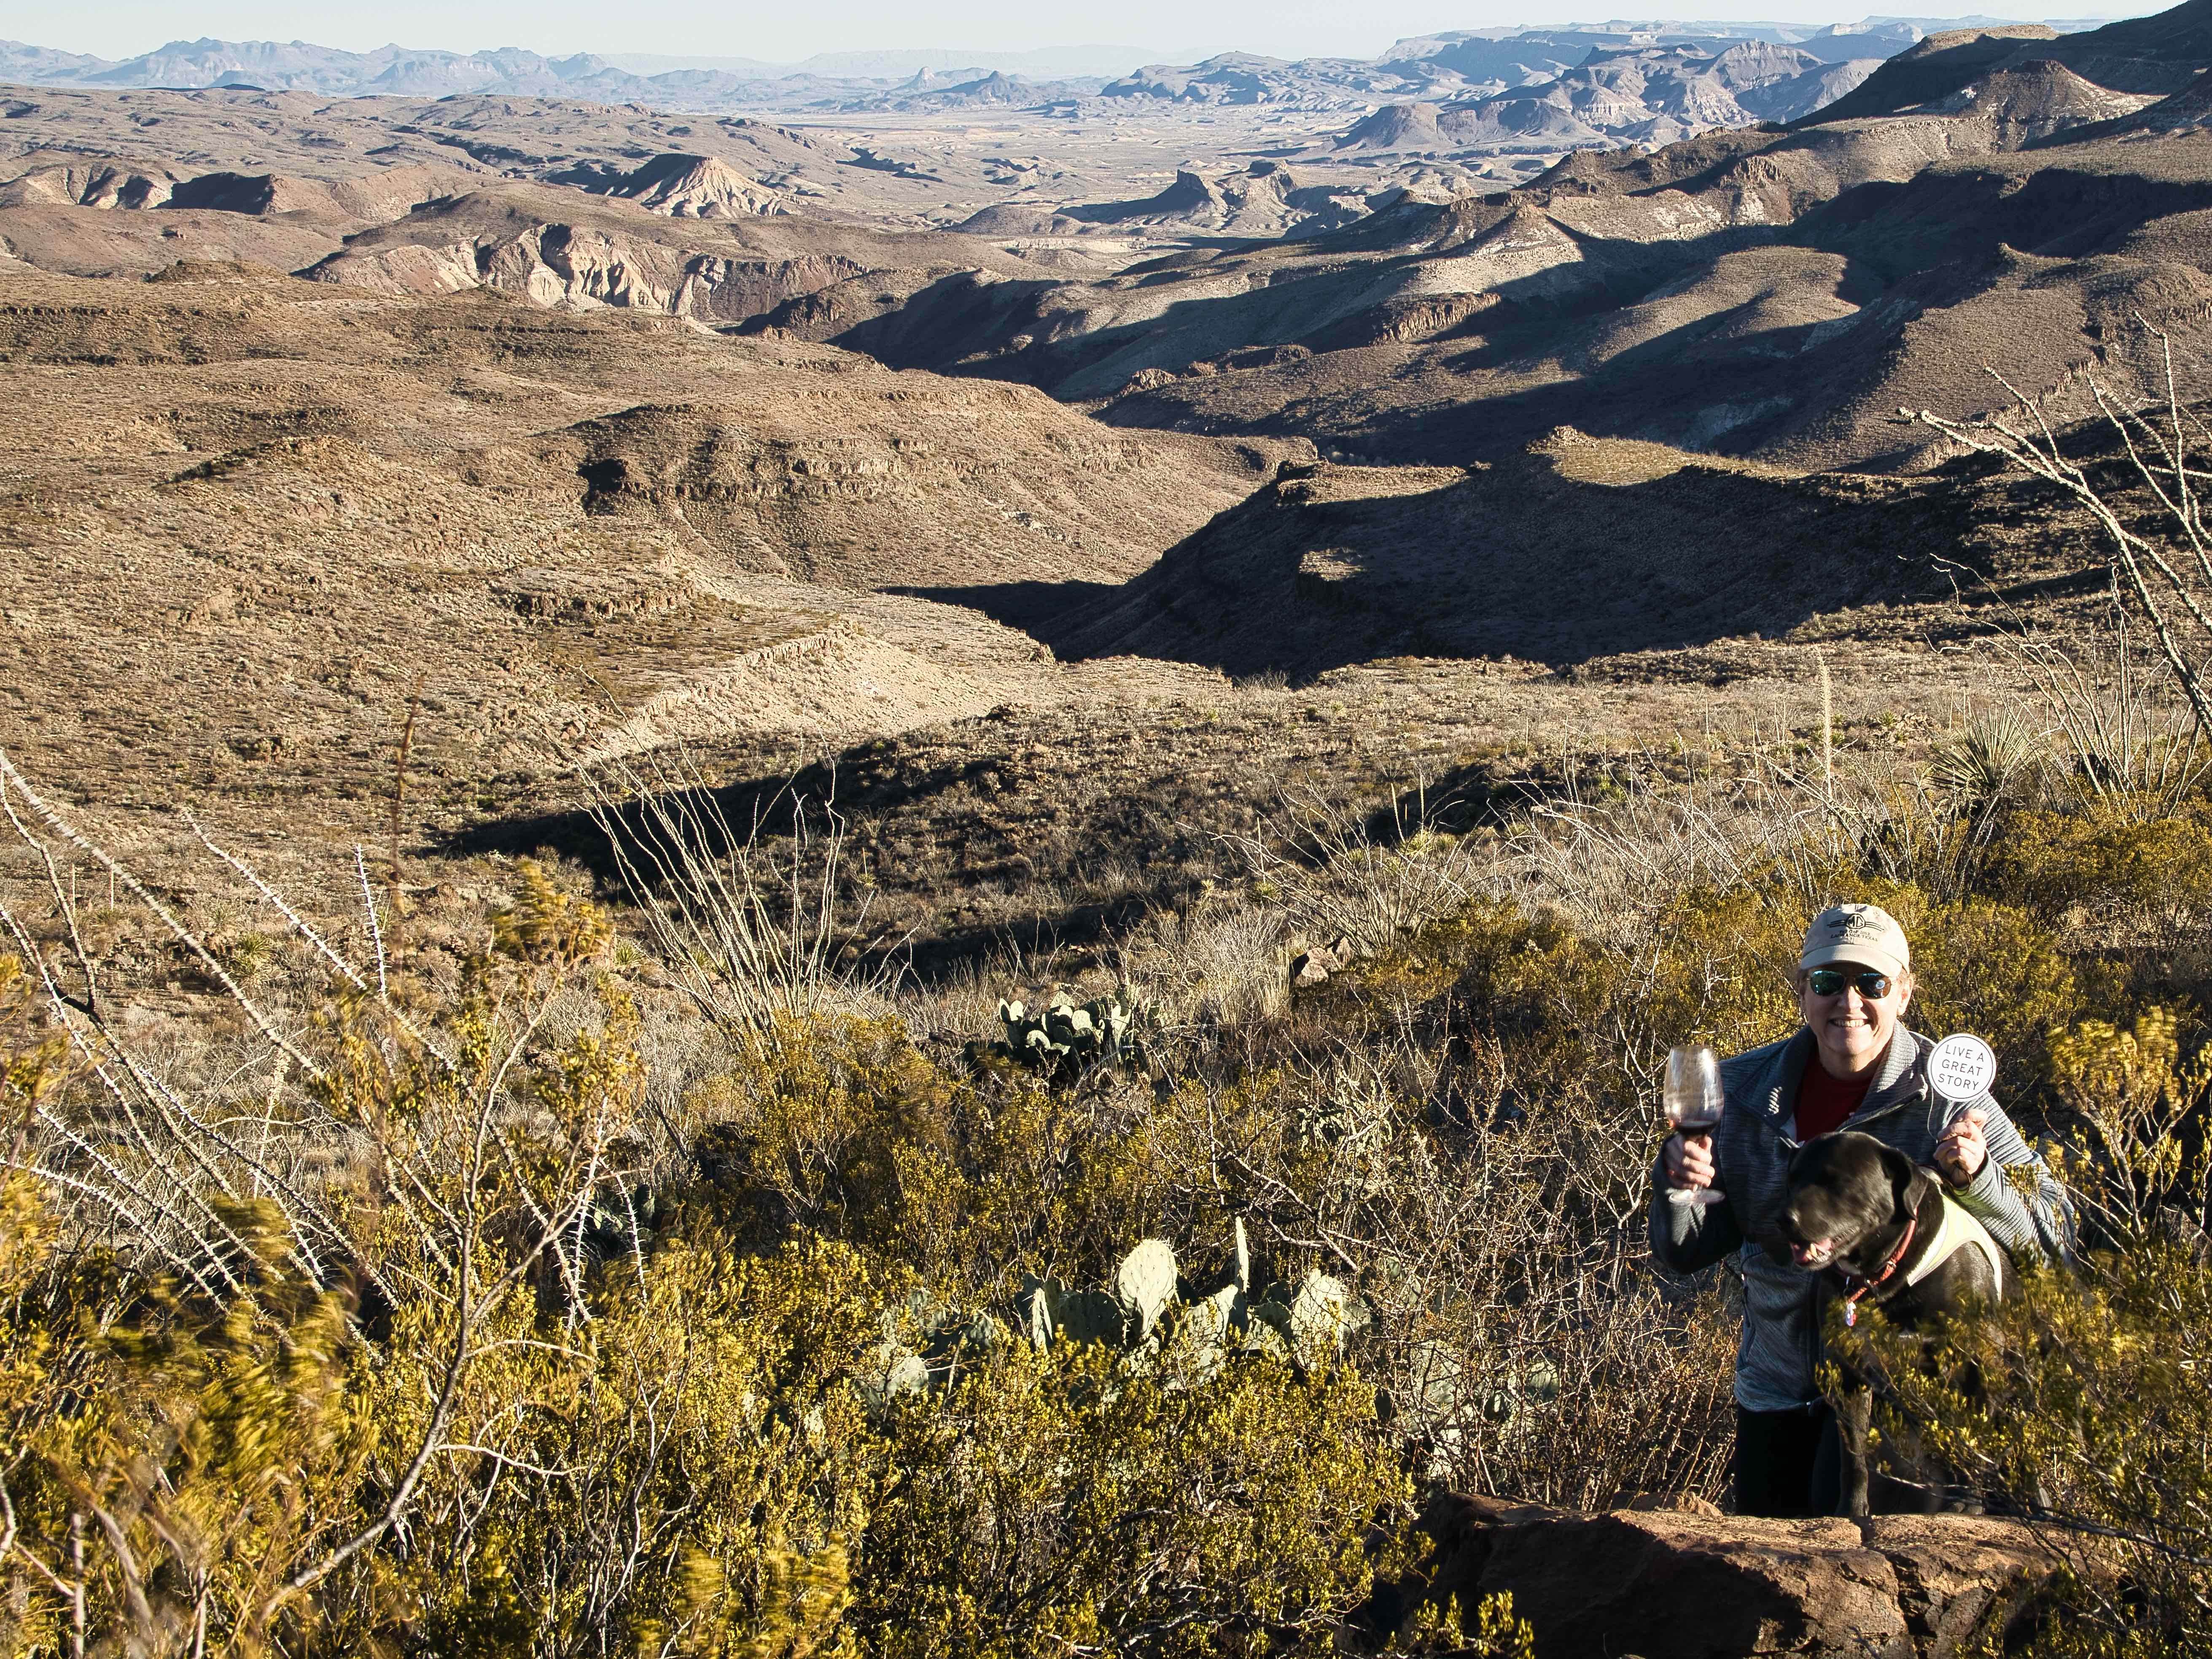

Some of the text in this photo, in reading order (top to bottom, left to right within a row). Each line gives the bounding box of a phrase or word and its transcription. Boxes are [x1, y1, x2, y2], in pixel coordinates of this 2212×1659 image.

[1848, 916, 1863, 928] MG
[1945, 1044, 1984, 1062] LIVE A
[1942, 1059, 1983, 1076] GREAT
[1938, 1073, 1979, 1090] STORY
